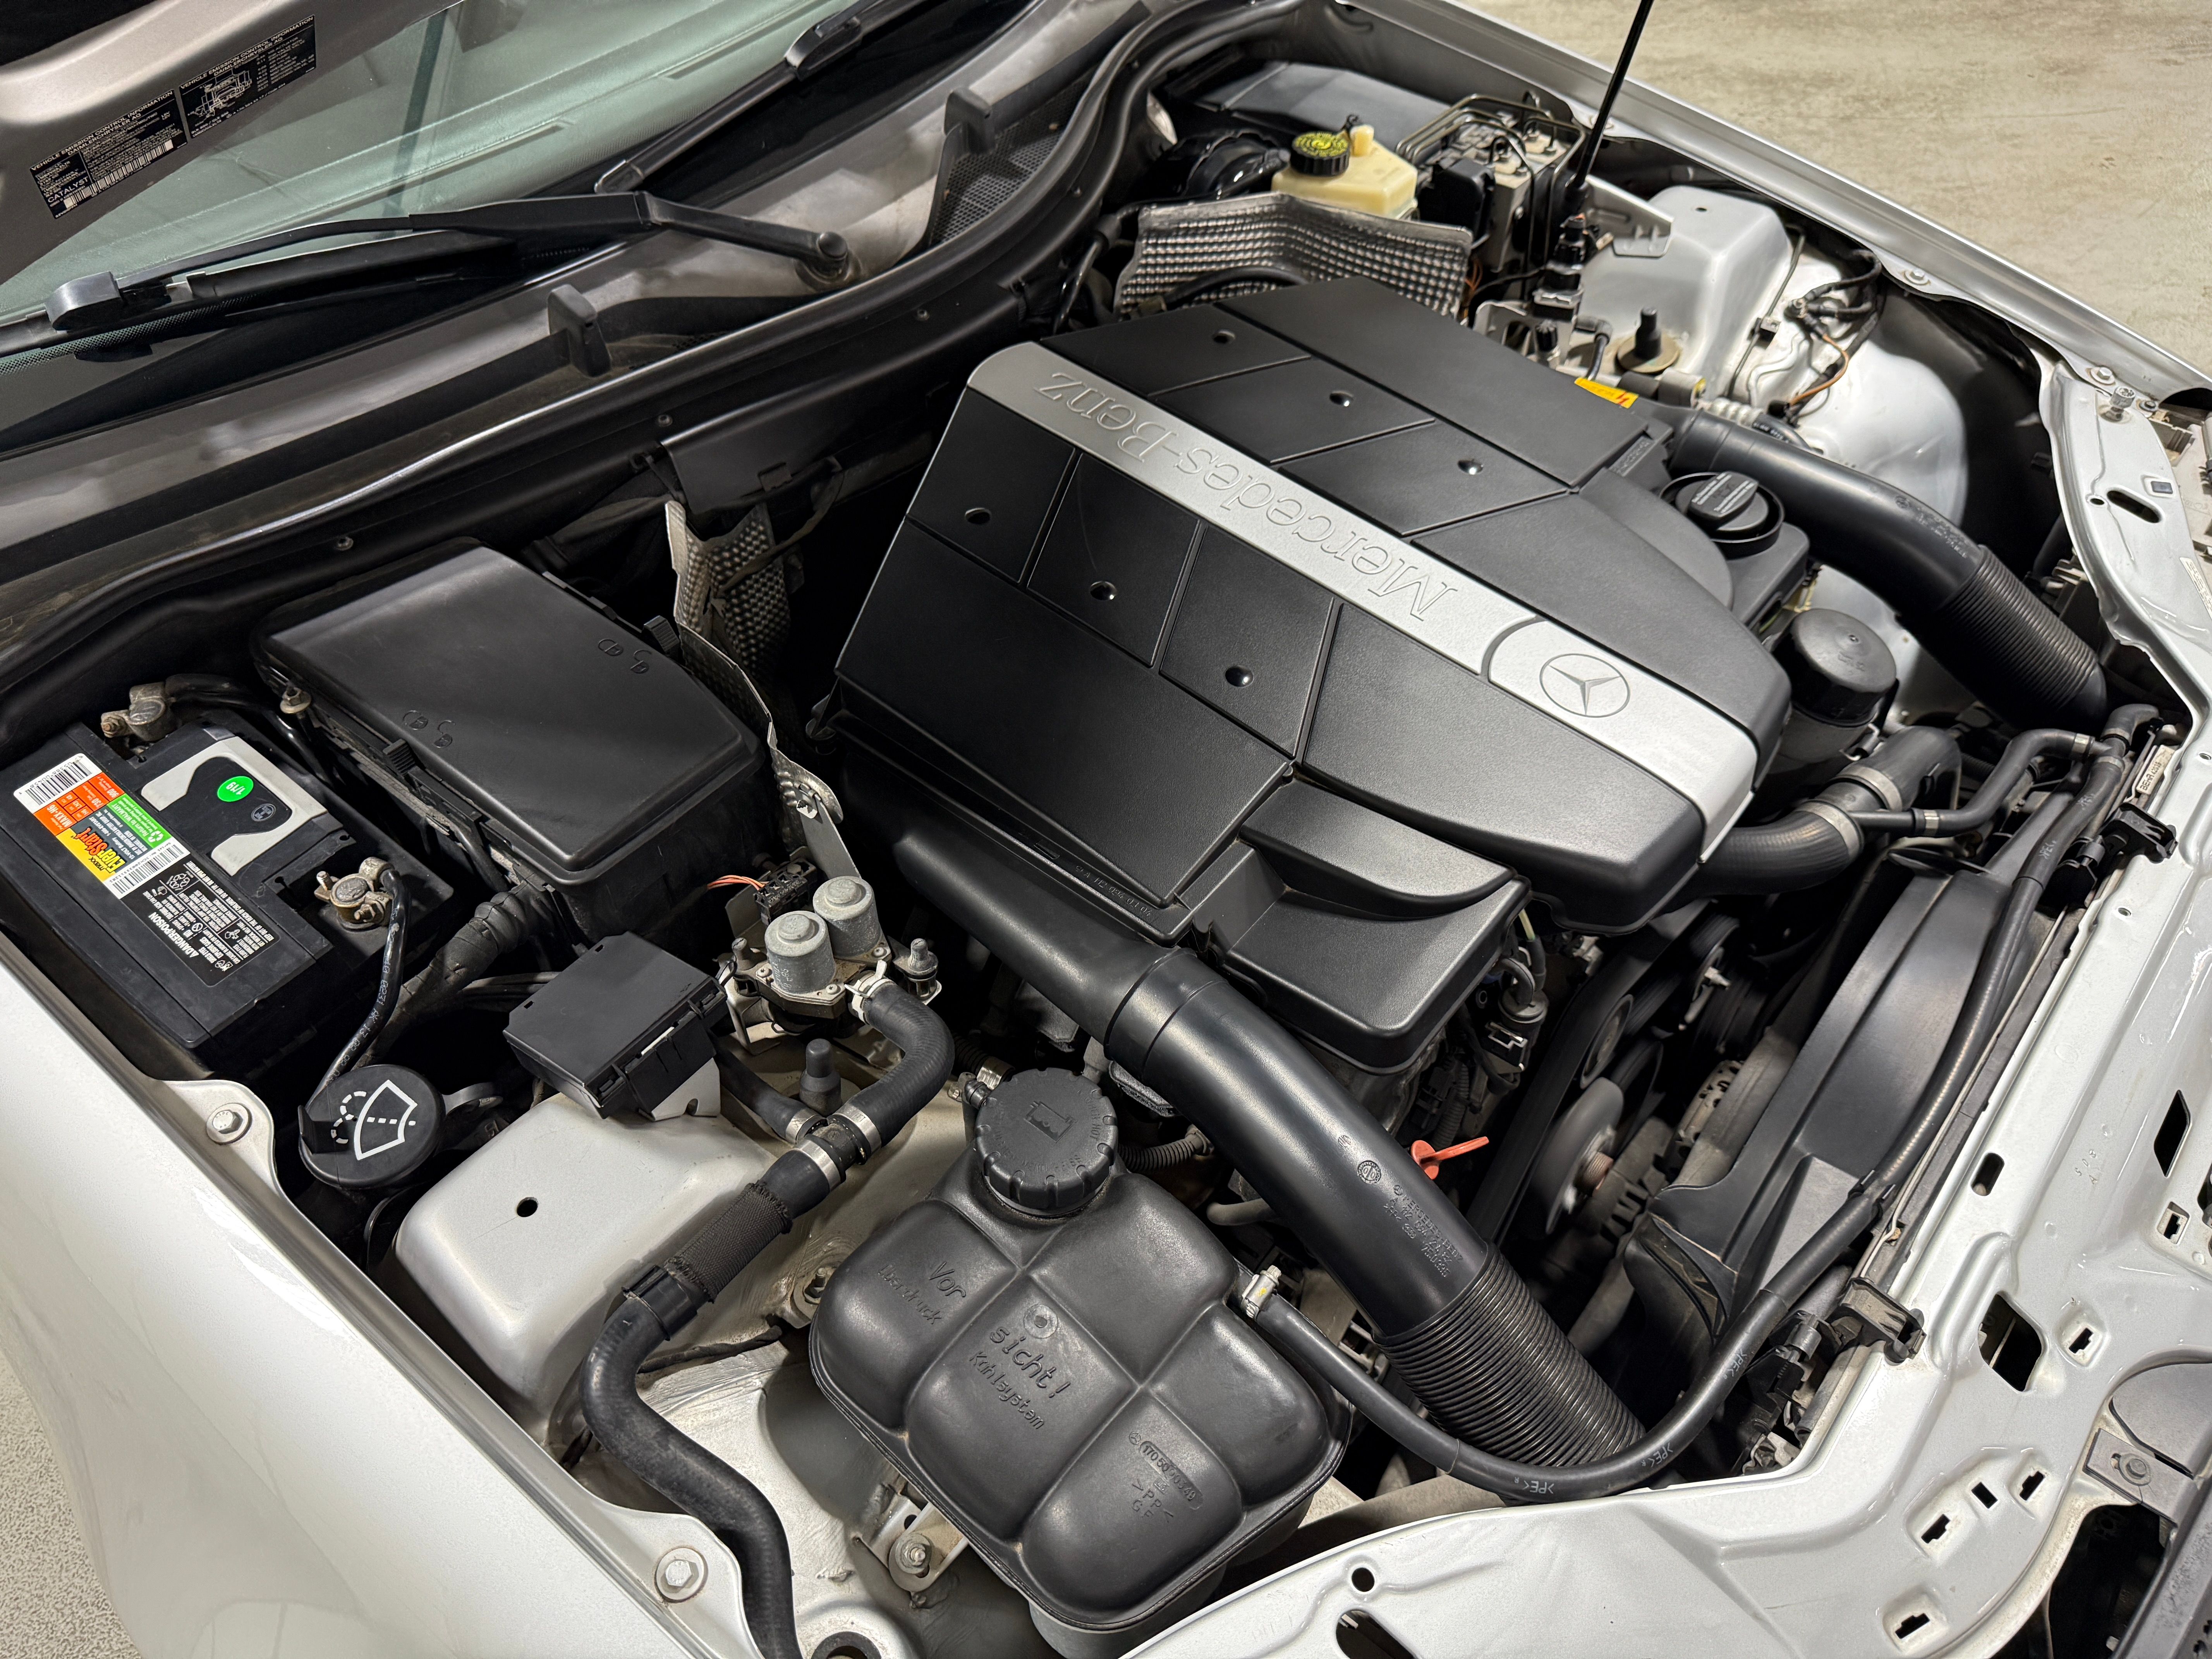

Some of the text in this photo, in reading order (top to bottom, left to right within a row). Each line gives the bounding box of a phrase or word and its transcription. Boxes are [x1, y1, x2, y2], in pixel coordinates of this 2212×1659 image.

[180, 72, 207, 89] VEHICLE
[208, 55, 239, 74] EMISSION
[240, 40, 270, 57] CONTROL
[271, 15, 313, 41] INFORMATION
[30, 153, 60, 170] VEHICLE
[61, 134, 94, 154] EMISSION
[94, 117, 127, 137] CONTROL
[127, 91, 172, 118] INFORMATION
[48, 176, 88, 203] CATALYST
[1034, 372, 1458, 622] Mercedes-Benz
[106, 788, 119, 798] 900
[226, 781, 246, 796] 1/19
[91, 798, 103, 807] 730
[111, 803, 132, 822] WALMART
[134, 823, 149, 837] Return
[71, 826, 126, 874] EverStart
[110, 836, 125, 849] Battery
[120, 847, 135, 859] 12-VOLT
[88, 856, 105, 871] maxx
[148, 912, 194, 954] DANGER/POISON
[183, 929, 193, 938] NO
[198, 946, 209, 955] EYES
[929, 1261, 966, 1298] Vor
[1649, 1442, 1673, 1468] >PE<
[1523, 1480, 1554, 1494] >PE<
